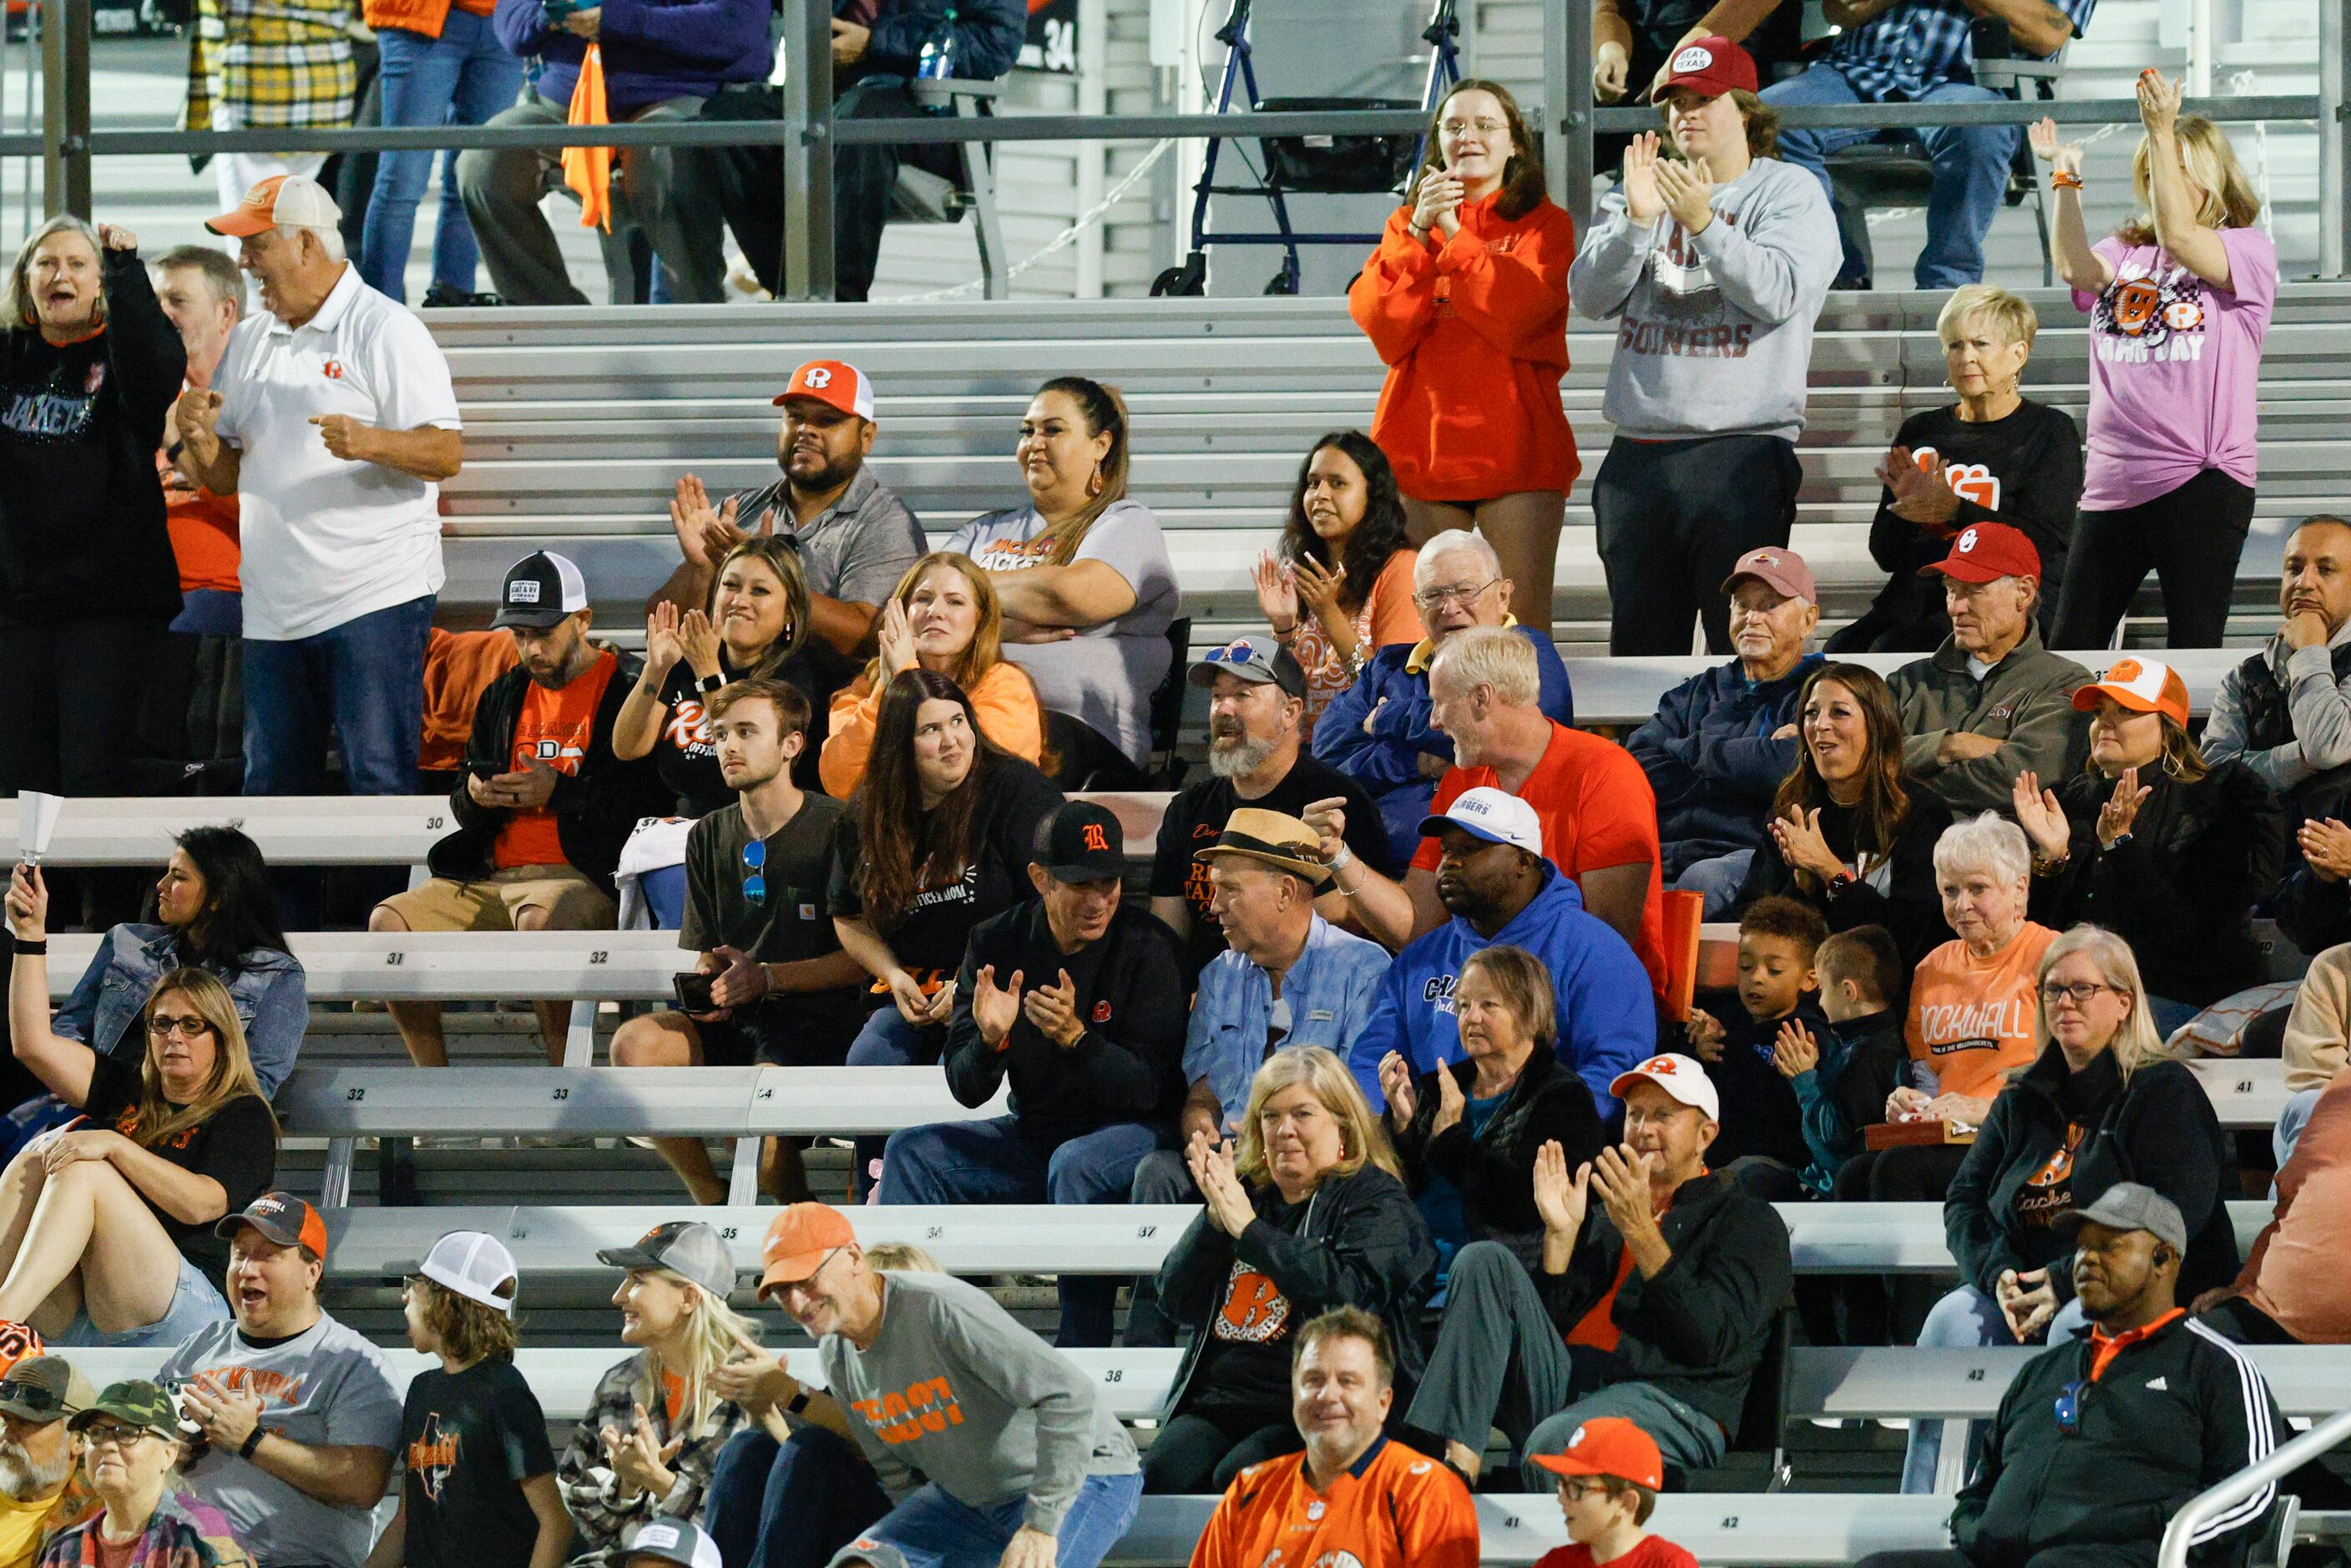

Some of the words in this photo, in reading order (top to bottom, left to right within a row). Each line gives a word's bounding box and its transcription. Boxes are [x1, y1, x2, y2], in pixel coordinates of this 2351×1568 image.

[1680, 50, 1705, 60] BEAT
[1676, 59, 1706, 69] TEXAS
[2166, 303, 2199, 329] R
[804, 367, 832, 388] R
[427, 817, 443, 829] 30
[1082, 823, 1110, 852] R
[387, 952, 402, 964] 31
[590, 951, 608, 964] 32
[1643, 1056, 1677, 1076] R
[2236, 1081, 2252, 1093] 41
[346, 1088, 366, 1101] 32
[553, 1088, 569, 1100] 33
[721, 1227, 738, 1239] 35
[1105, 1369, 1123, 1383] 38
[1968, 1368, 1985, 1381] 42
[1504, 1517, 1519, 1528] 41
[1722, 1516, 1738, 1529] 42
